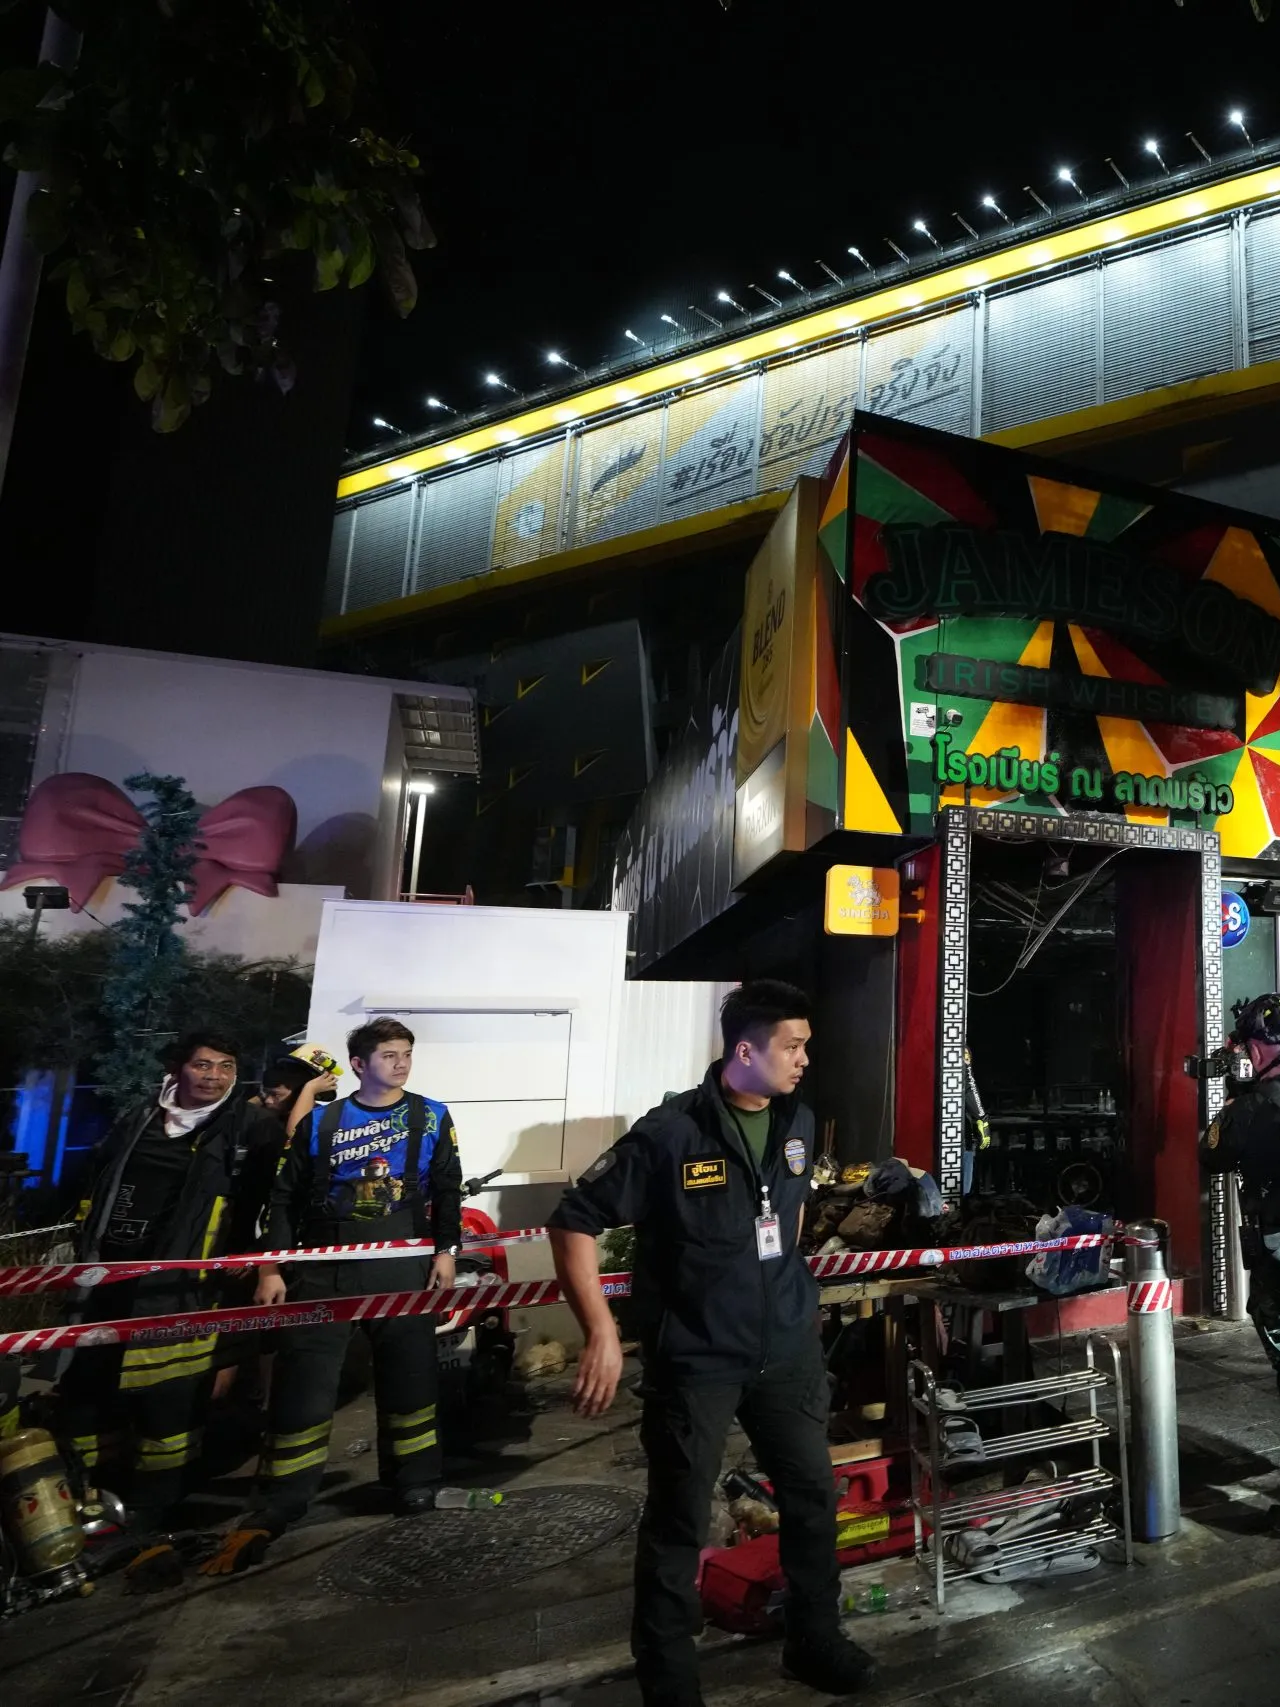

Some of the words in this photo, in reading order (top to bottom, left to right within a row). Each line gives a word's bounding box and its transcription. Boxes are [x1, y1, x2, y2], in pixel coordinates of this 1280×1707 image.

[751, 590, 786, 668] BLEND
[937, 660, 1050, 698] IRISH
[931, 731, 1060, 796] โรงเบียร์
[1070, 766, 1102, 800] ณ
[1113, 770, 1235, 815] ลาดพร้าว
[744, 792, 780, 842] PARKIN
[129, 1303, 336, 1342] เขตอันตรายห้ามเข้า
